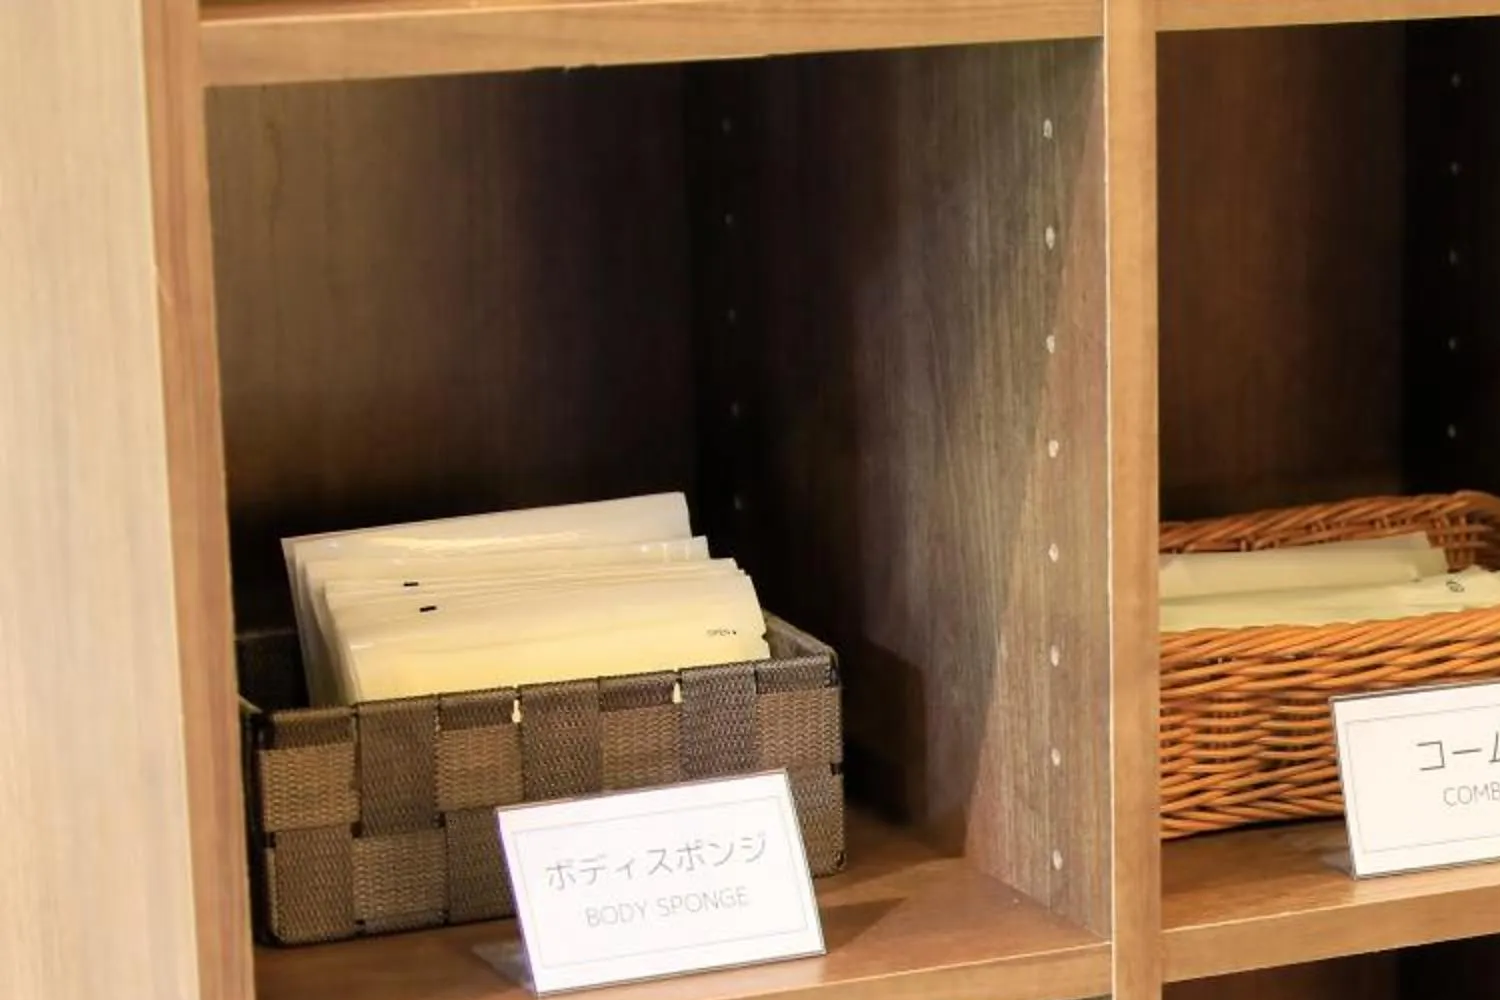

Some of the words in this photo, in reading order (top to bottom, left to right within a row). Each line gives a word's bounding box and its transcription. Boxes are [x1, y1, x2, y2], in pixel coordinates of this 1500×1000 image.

[545, 830, 768, 892] ボディスポンジ
[585, 900, 648, 928] BODY
[656, 886, 750, 918] SPONGE
